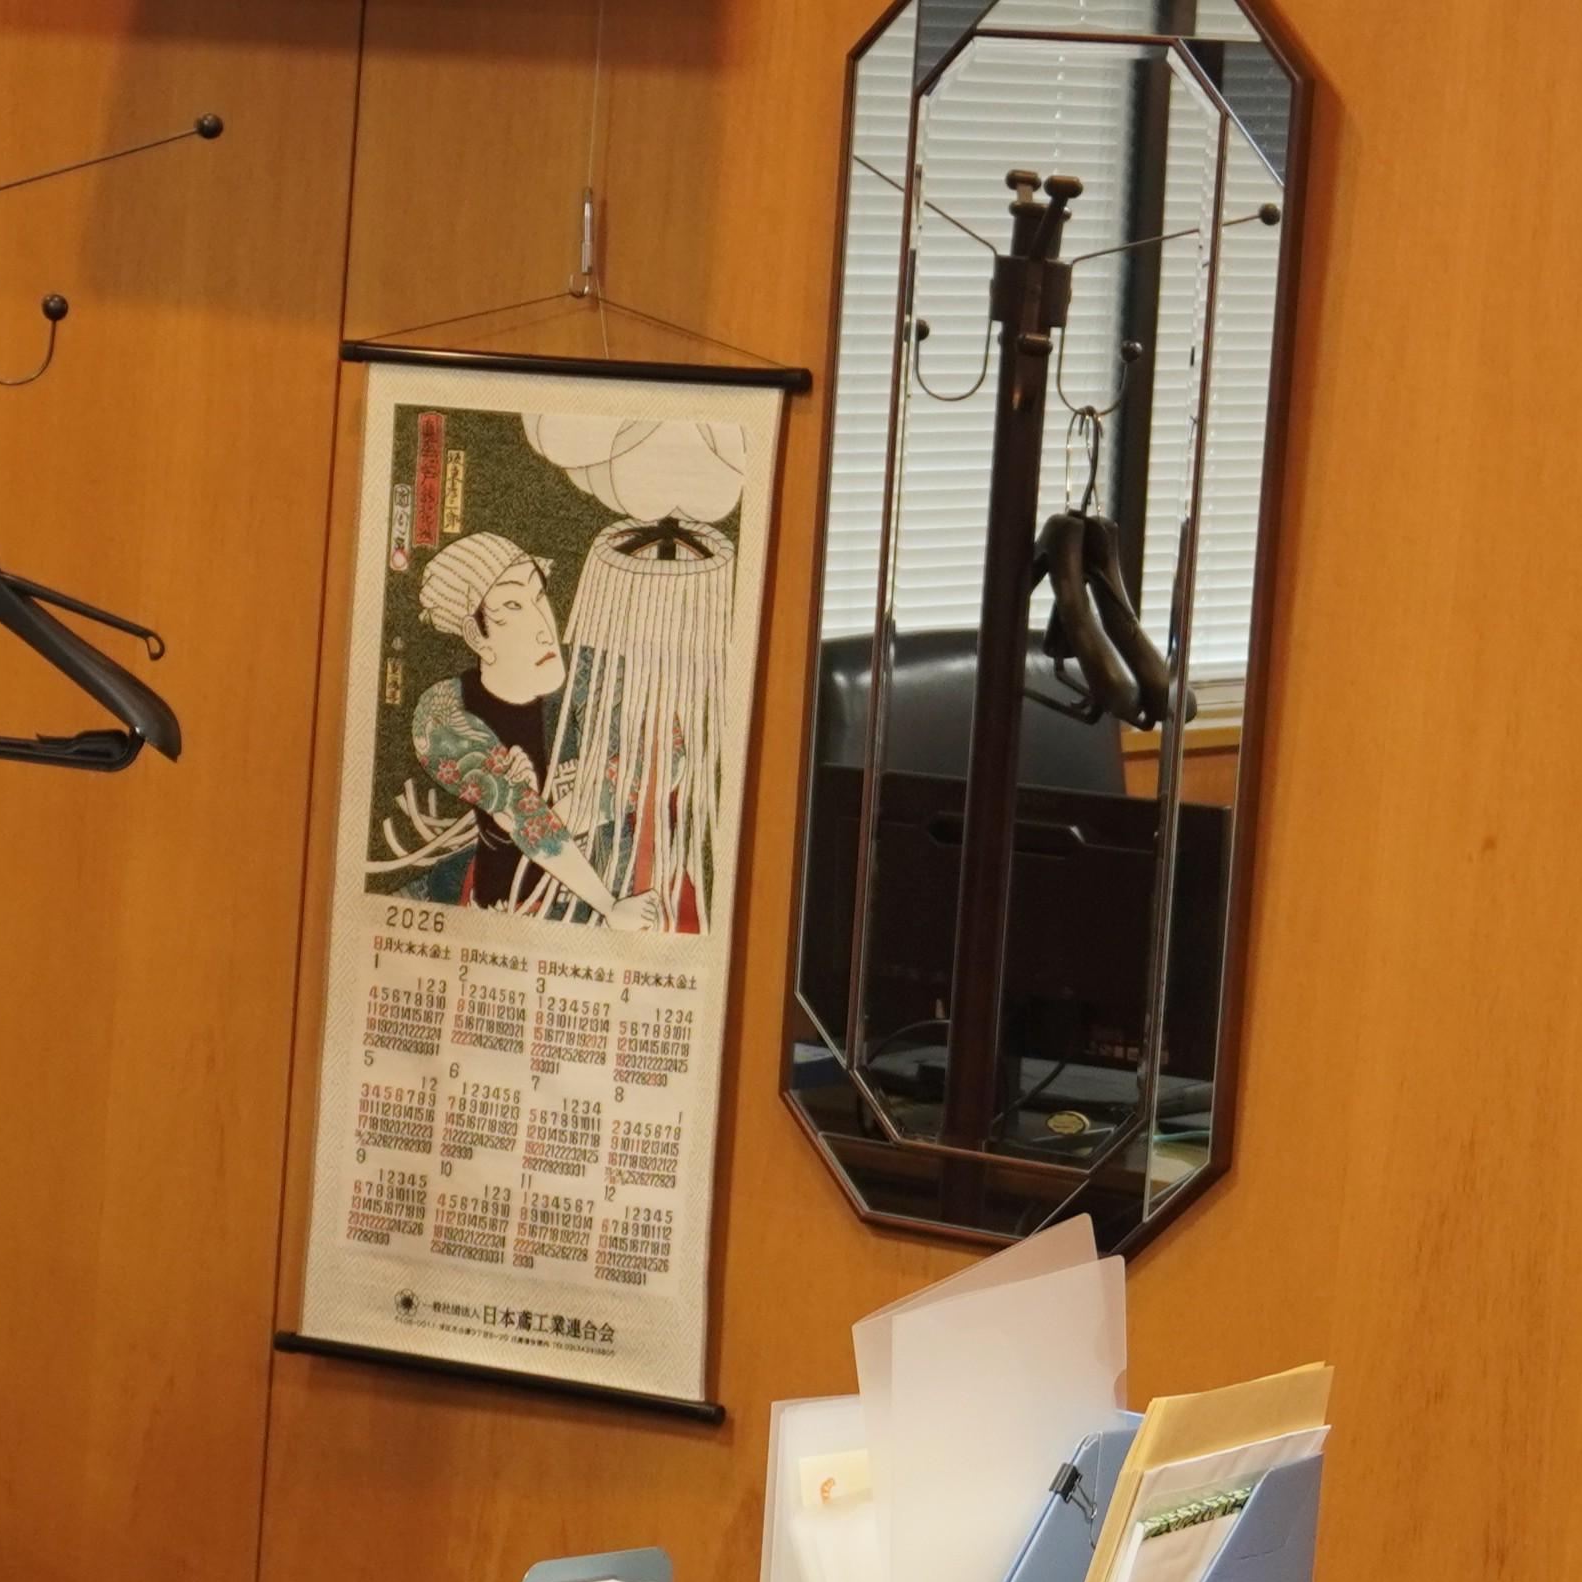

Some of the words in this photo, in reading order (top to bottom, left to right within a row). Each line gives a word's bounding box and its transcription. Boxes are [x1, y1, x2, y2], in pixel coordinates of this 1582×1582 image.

[386, 906, 445, 932] 2026
[374, 953, 379, 968] 1
[459, 966, 468, 982] 2
[536, 978, 545, 993] 3
[621, 988, 629, 1003] 4
[364, 1050, 374, 1067] 5
[449, 1063, 459, 1078] 6
[532, 1076, 540, 1090] 7
[615, 1087, 624, 1103] 8
[356, 1148, 366, 1164] 9
[441, 1161, 452, 1177] 10
[521, 1173, 532, 1189] 11
[605, 1186, 616, 1202] 12
[482, 1305, 615, 1344] 日本鳶工業連合会
